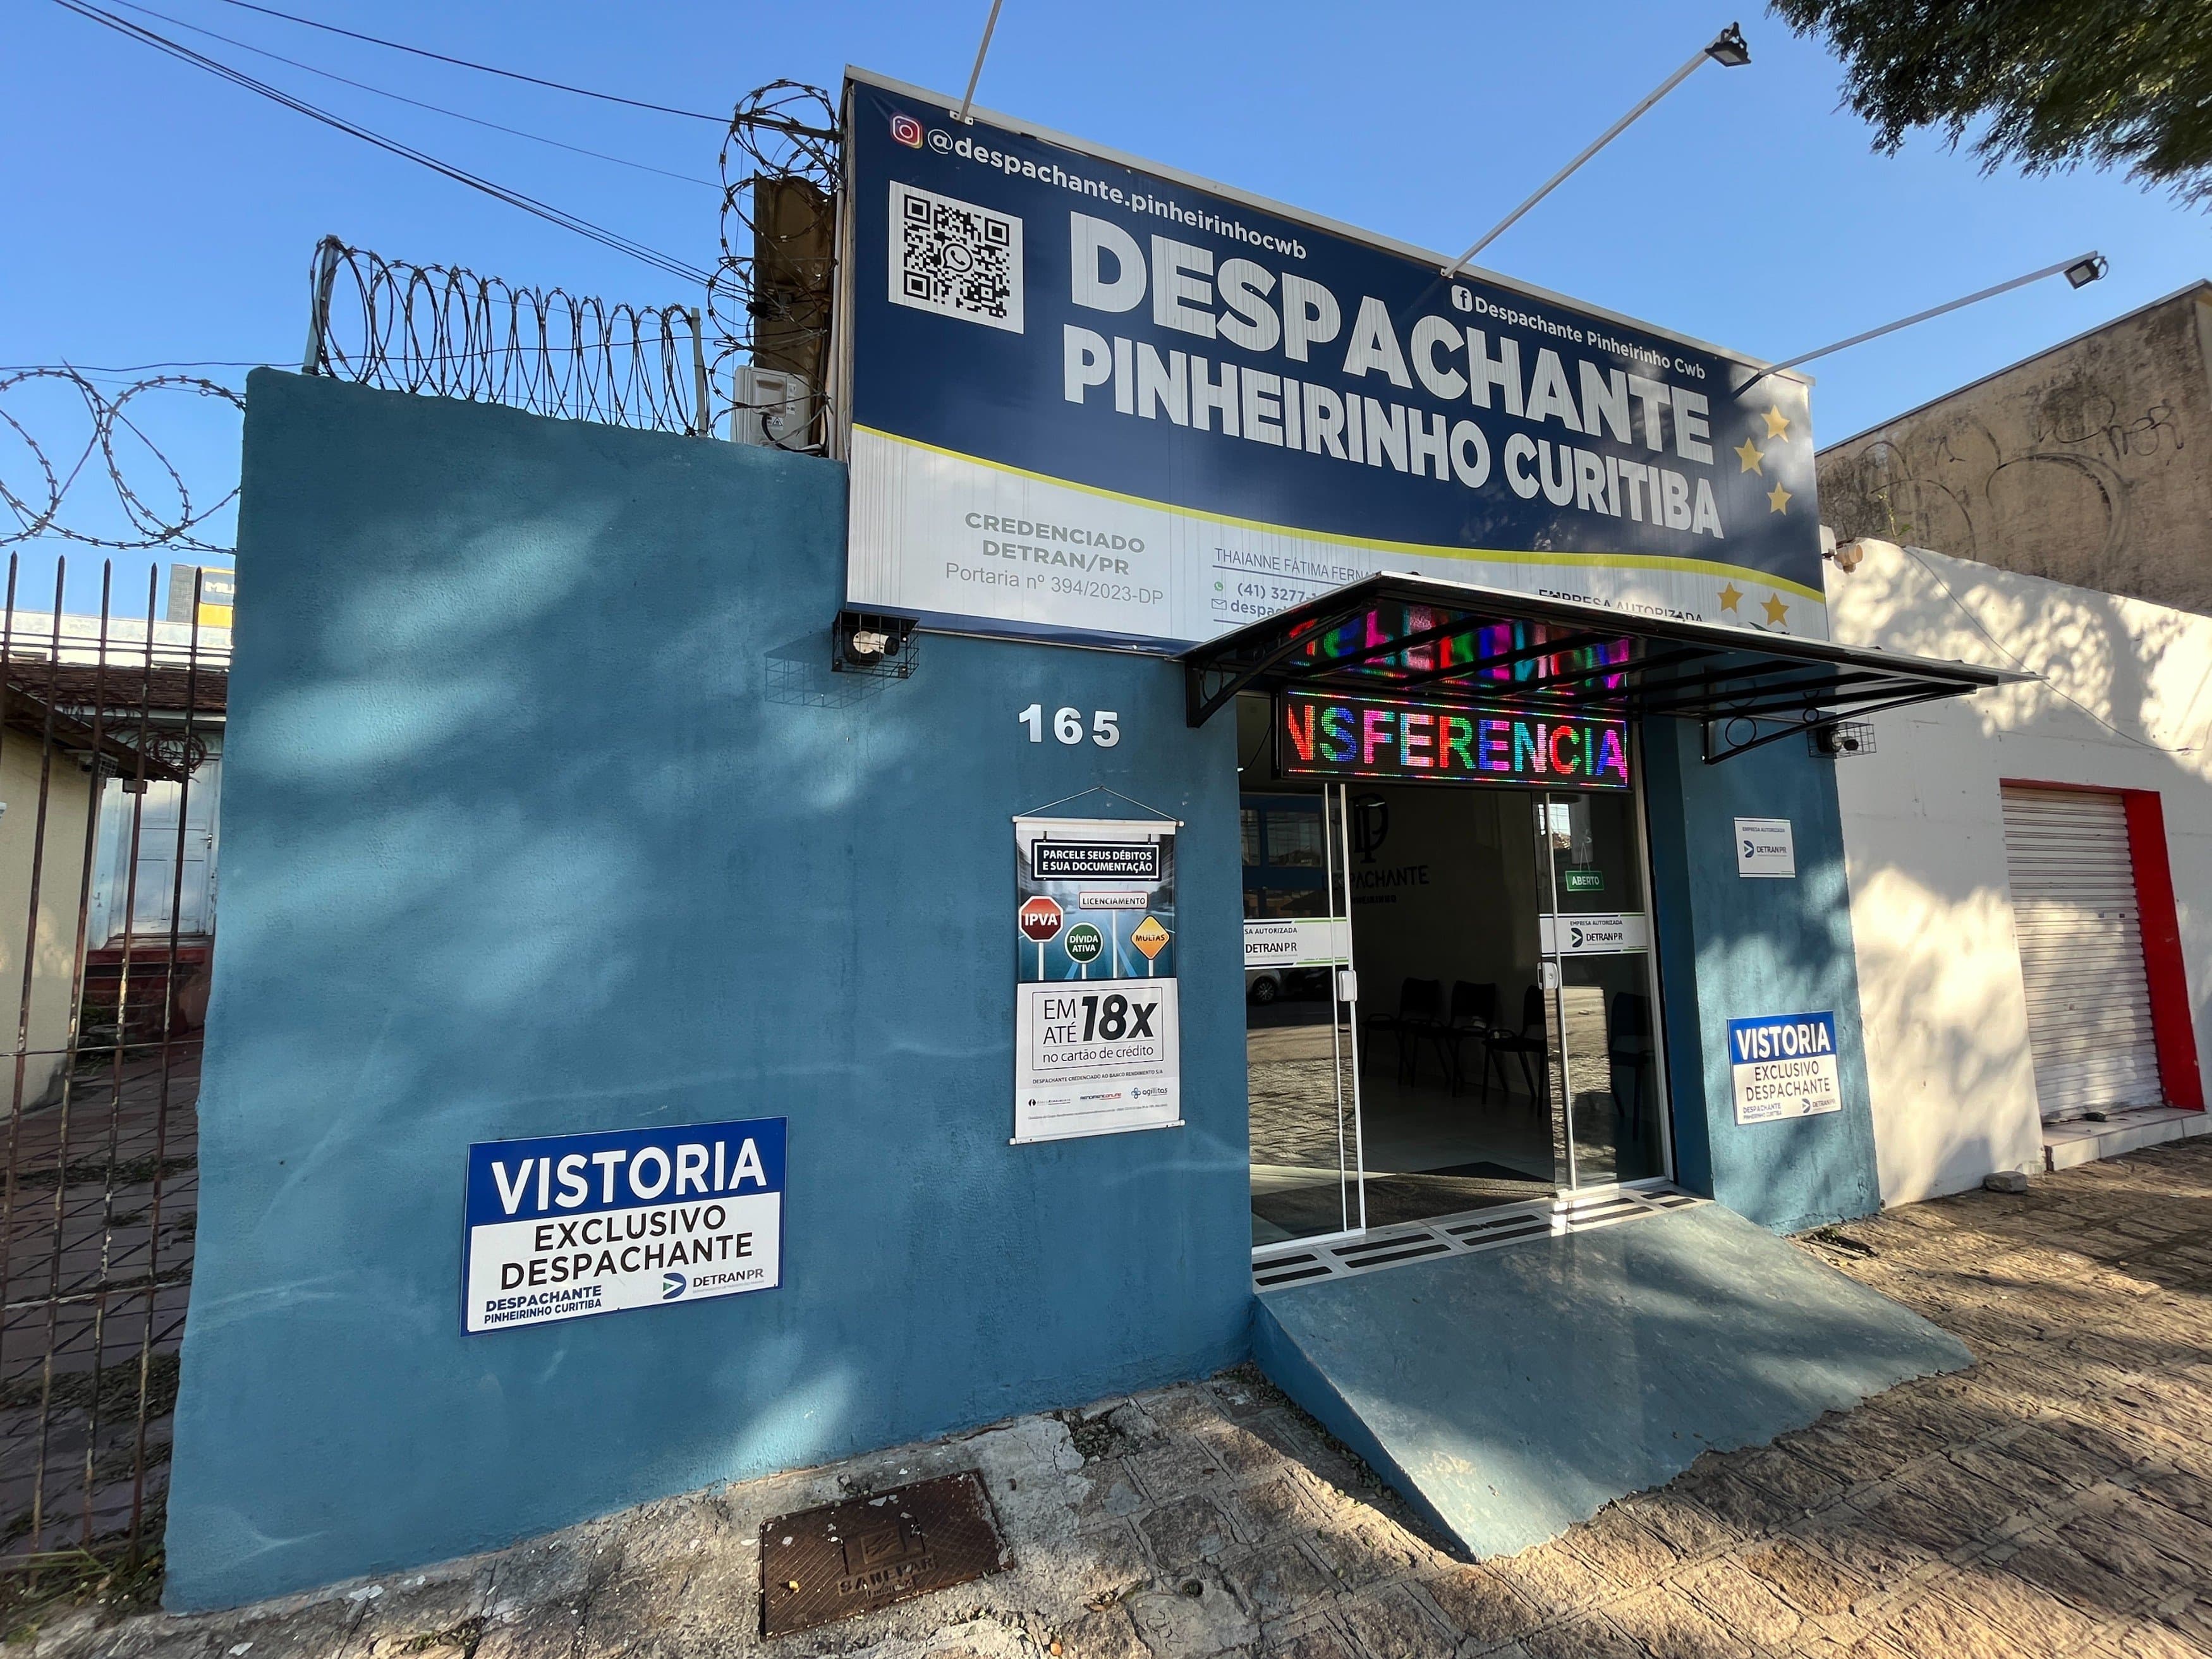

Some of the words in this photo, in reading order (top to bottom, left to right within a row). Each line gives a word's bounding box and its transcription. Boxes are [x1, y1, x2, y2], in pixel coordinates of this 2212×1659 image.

[927, 128, 1306, 259] @despachante.pinheirinhocwb
[1070, 210, 1713, 465] DESPACHANTE
[1475, 296, 1583, 343] Despachante
[1587, 331, 1670, 369] Pinheirinho
[1675, 358, 1706, 380] Cwb
[1064, 324, 1490, 489] PINHEIRINHO
[1504, 432, 1724, 538] CURITIBA
[964, 512, 1145, 554] CREDENCIADO
[982, 540, 1129, 576] DETRAN/PR
[1214, 547, 1280, 571] THAIANNE
[1284, 556, 1328, 577] FÁTIMA
[946, 562, 1019, 590] Portaria
[1051, 576, 1164, 605] 394/2023-DP
[1237, 583, 1265, 600] (41)
[1018, 703, 1121, 748] 165
[1287, 703, 1627, 781] NSFERENCIA
[1043, 850, 1085, 860] PARCELE
[1088, 851, 1111, 860] SEUS
[1113, 849, 1152, 861] DÉBITOS
[1043, 861, 1048, 870] E
[1050, 861, 1070, 871] SUA
[1073, 861, 1153, 873] DOCUMENTAÇÃO
[1572, 876, 1600, 885] ABERTO
[1024, 913, 1058, 927] IPVA
[1069, 934, 1098, 944] DÍVIDA
[1072, 944, 1096, 952] ATIVA
[1043, 998, 1076, 1020] EM
[1081, 994, 1158, 1042] 18x
[1043, 1021, 1078, 1045] ATÉ
[1736, 1022, 1831, 1060] VISTORIA
[1043, 1052, 1058, 1064] no
[1060, 1048, 1097, 1062] cartão
[1099, 1047, 1114, 1059] de
[1115, 1044, 1154, 1057] crédito
[1754, 1060, 1819, 1081] EXCLUSIVO
[1746, 1078, 1830, 1102] DESPACHANTE
[1743, 1102, 1781, 1114] DESPACHANTE
[492, 1138, 767, 1215] VISTORIA
[535, 1205, 726, 1252] EXCLUSIVO
[501, 1232, 753, 1291] DESPACHANTE
[484, 1306, 552, 1324] PINHEIRINHO
[554, 1298, 602, 1316] CURITIBA
[485, 1285, 602, 1312] DESPACHANTE
